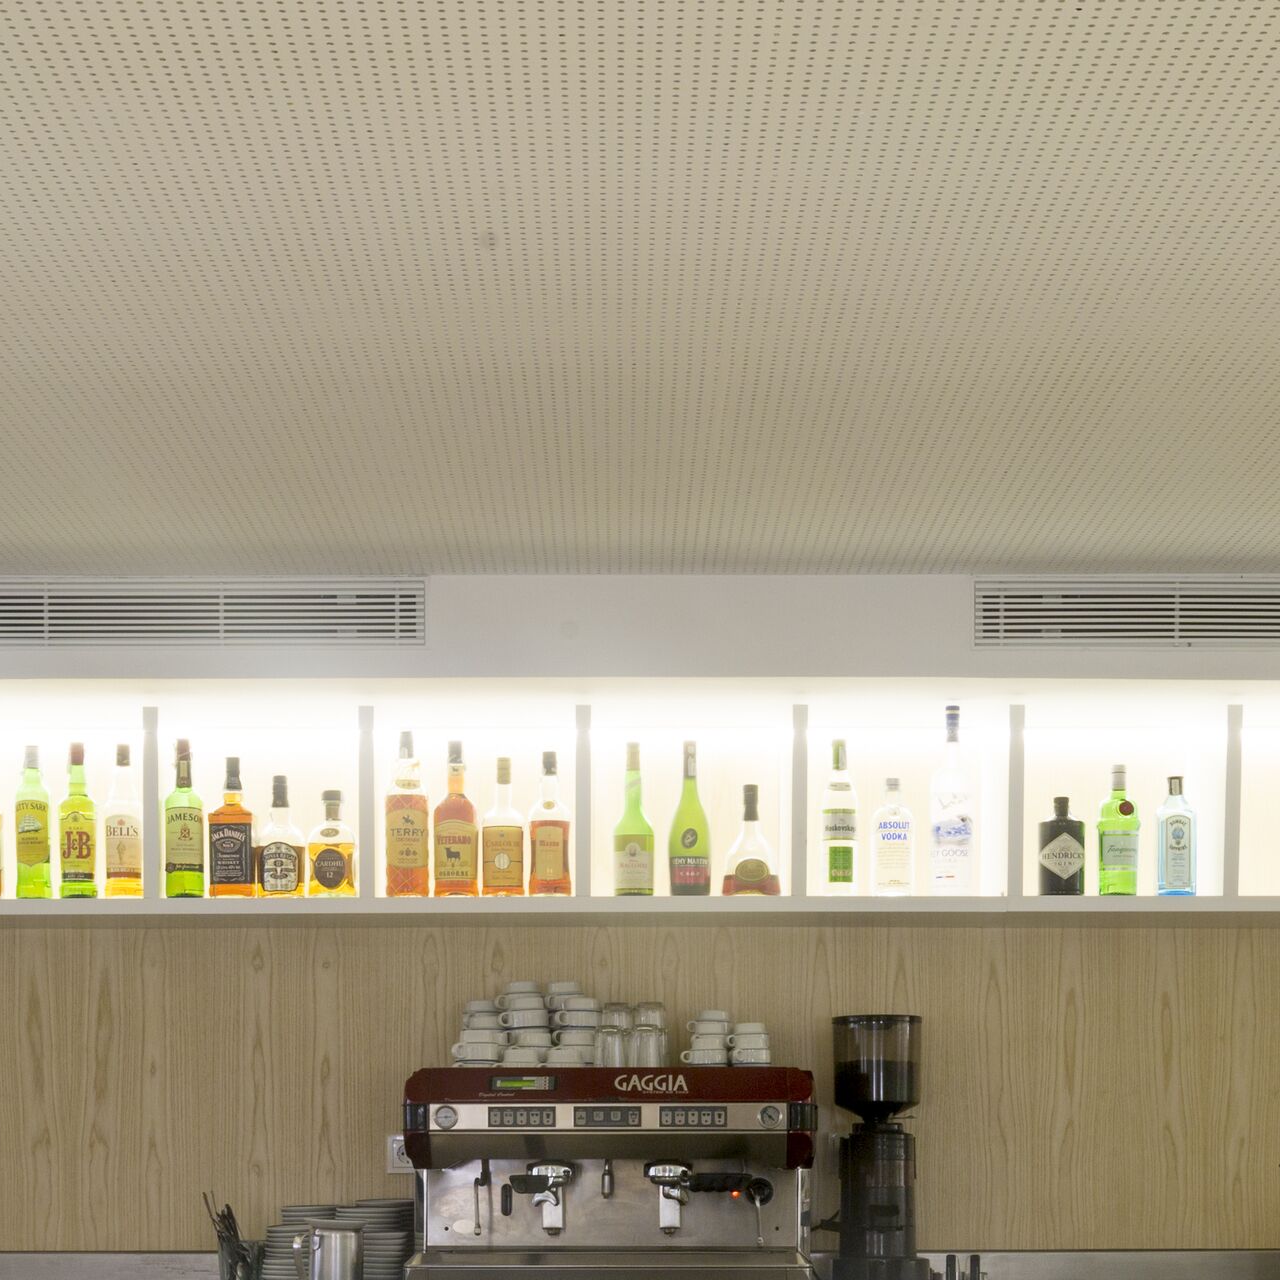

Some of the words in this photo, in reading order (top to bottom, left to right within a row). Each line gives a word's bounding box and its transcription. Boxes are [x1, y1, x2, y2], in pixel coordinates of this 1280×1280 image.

[878, 821, 910, 830] ABSOLUT
[105, 826, 139, 837] BELL'S
[211, 831, 223, 842] JACK
[390, 828, 425, 837] TERRY
[881, 832, 908, 841] VODKA
[437, 834, 471, 845] VETERANO
[614, 1074, 688, 1091] GAGGIA
